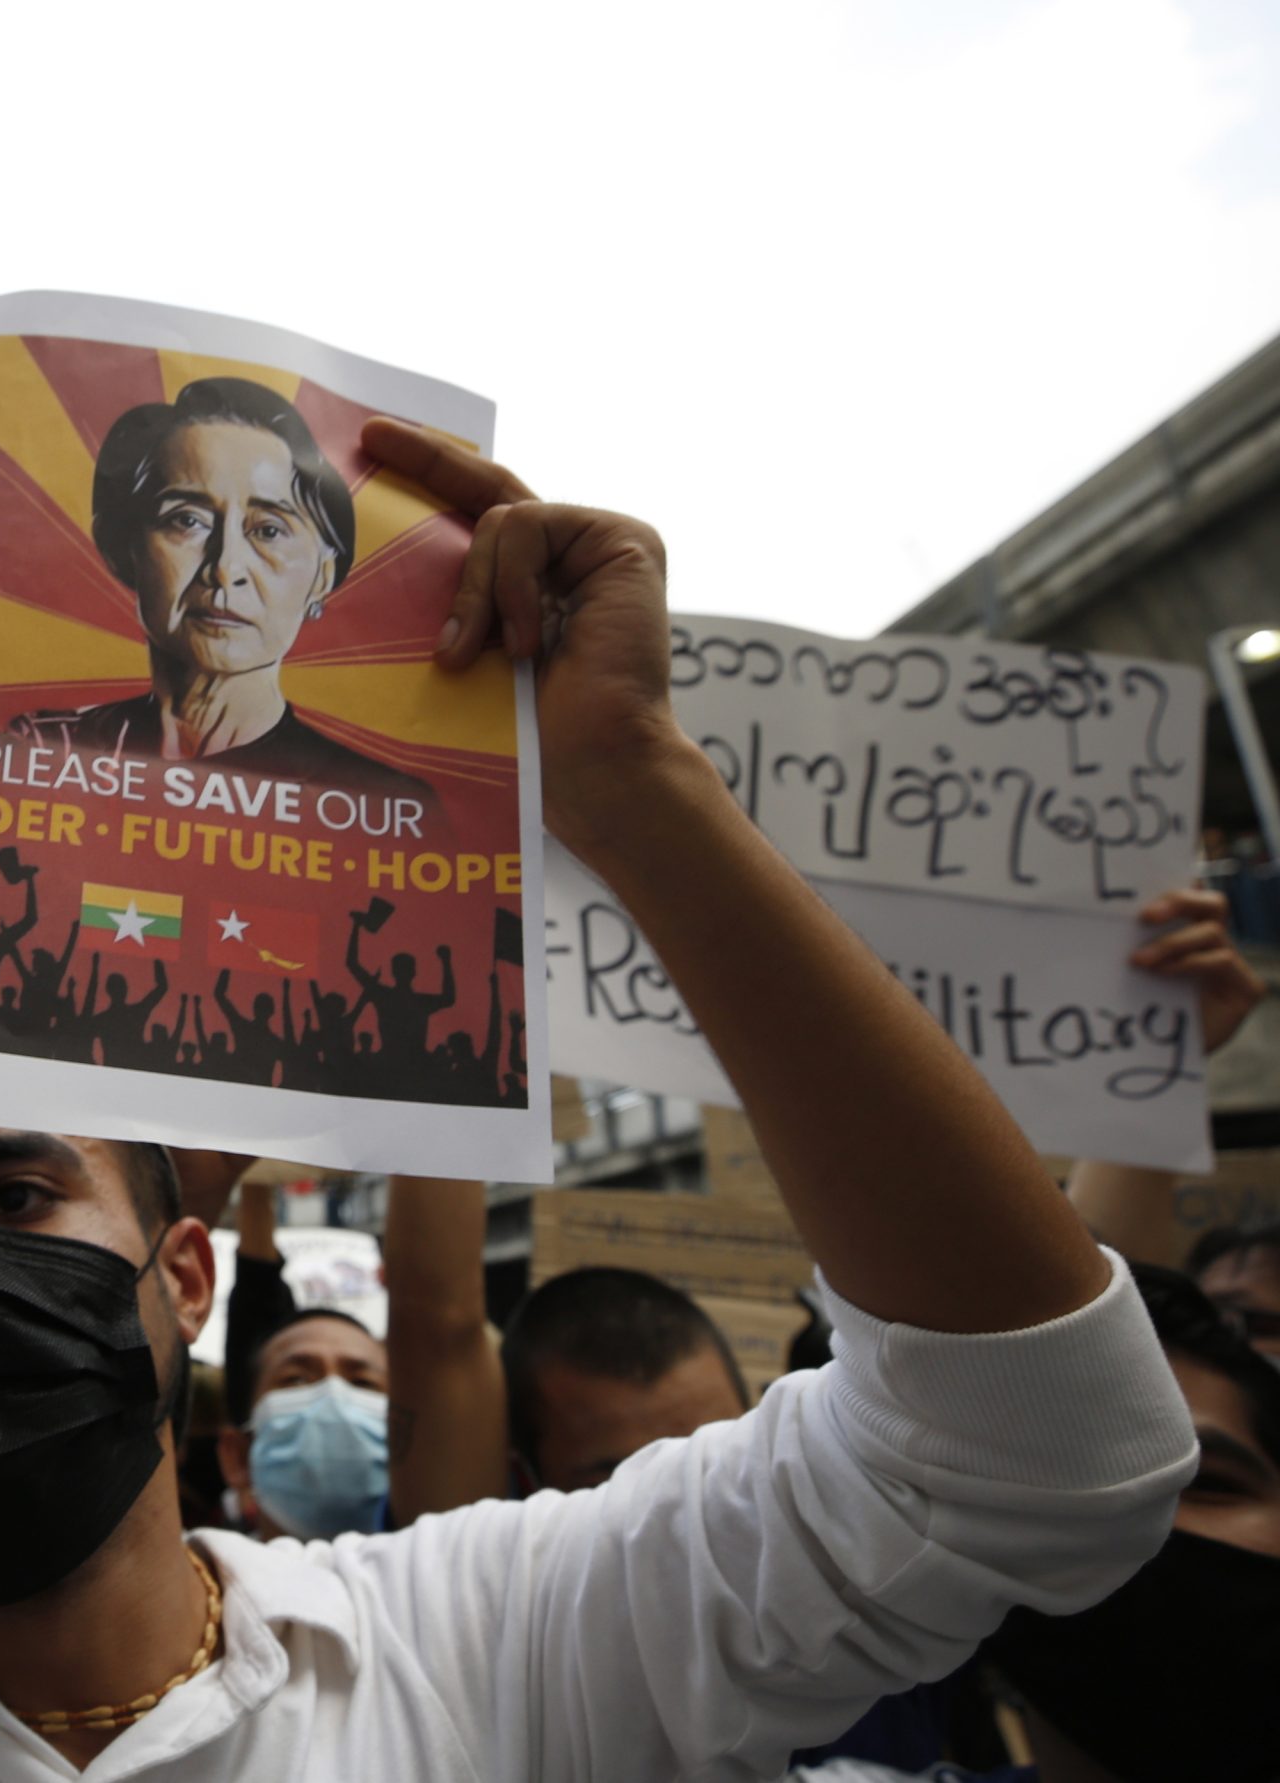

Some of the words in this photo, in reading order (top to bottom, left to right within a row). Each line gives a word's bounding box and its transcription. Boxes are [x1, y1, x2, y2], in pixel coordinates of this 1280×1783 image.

[163, 766, 301, 824] SAVE
[317, 790, 424, 839] OUR
[121, 813, 333, 882] FUTURE
[368, 849, 522, 894] HOPE
